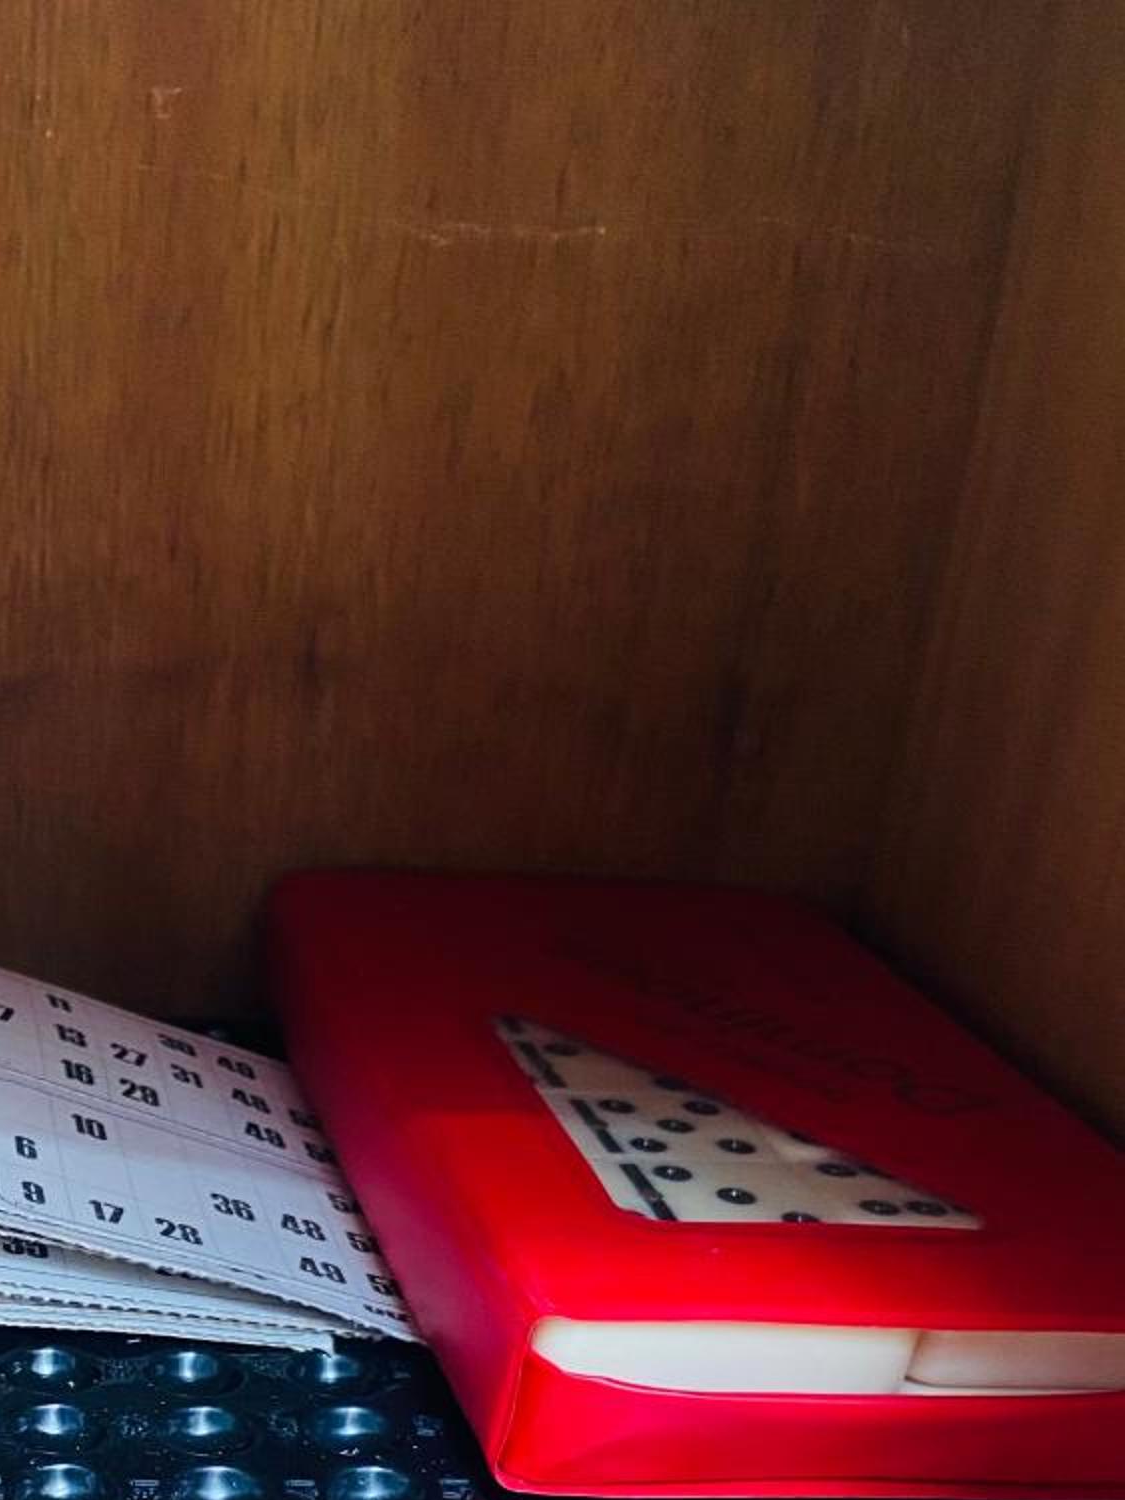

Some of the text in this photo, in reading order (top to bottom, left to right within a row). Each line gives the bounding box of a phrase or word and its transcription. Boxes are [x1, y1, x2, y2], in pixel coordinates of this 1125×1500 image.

[55, 1023, 88, 1048] 13
[110, 1043, 148, 1067] 27
[170, 1063, 203, 1089] 31
[71, 1113, 108, 1141] 10
[14, 1135, 38, 1159] 6
[210, 1192, 256, 1222] 36
[281, 1213, 326, 1242] 48
[21, 1181, 46, 1205] 9
[89, 1199, 124, 1224] 17
[155, 1217, 203, 1246] 28
[299, 1256, 348, 1284] 49
